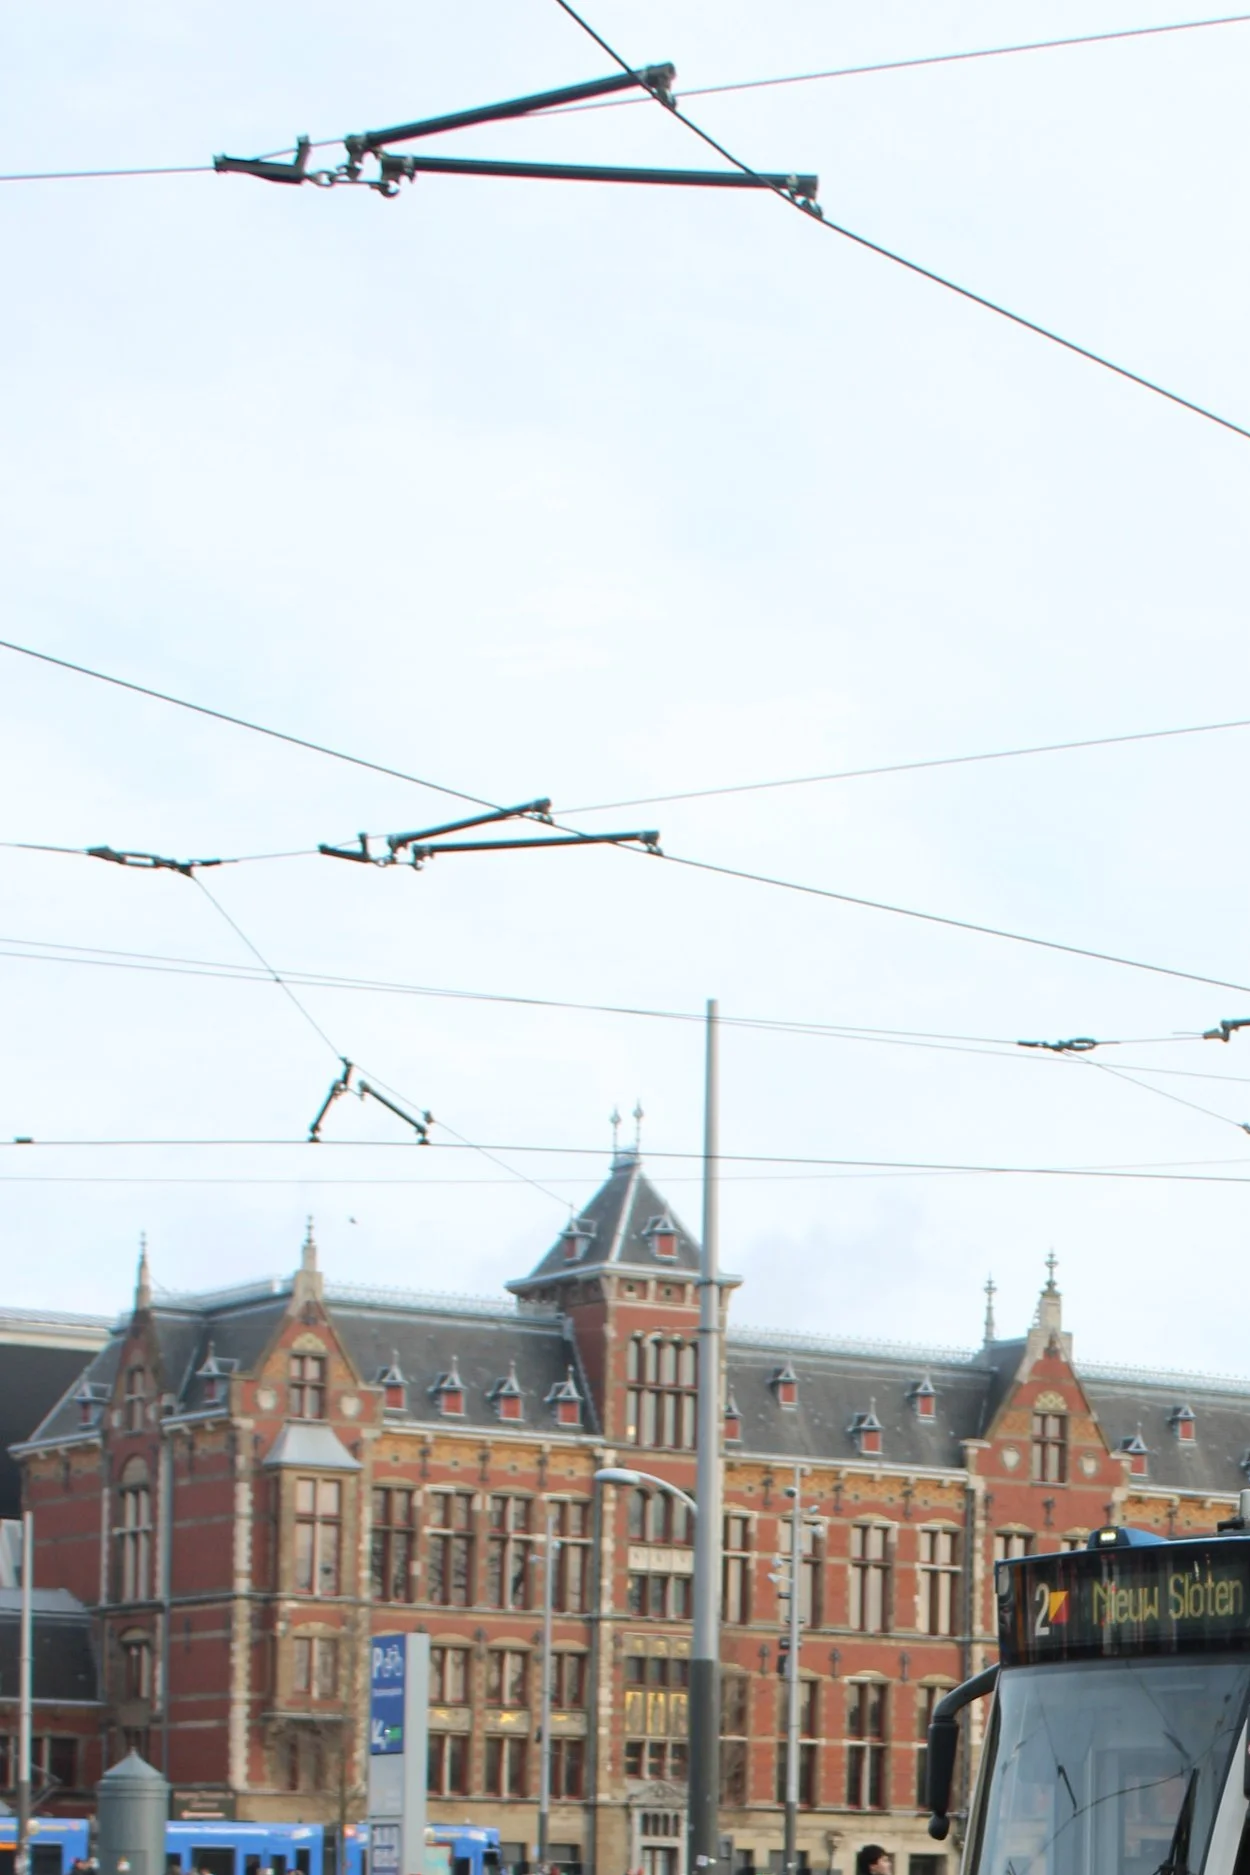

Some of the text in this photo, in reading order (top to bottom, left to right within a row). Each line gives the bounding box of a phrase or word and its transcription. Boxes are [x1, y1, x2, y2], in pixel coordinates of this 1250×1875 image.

[1035, 1574, 1243, 1636] 2 Nieuw Sloten
[373, 1647, 383, 1679] P
